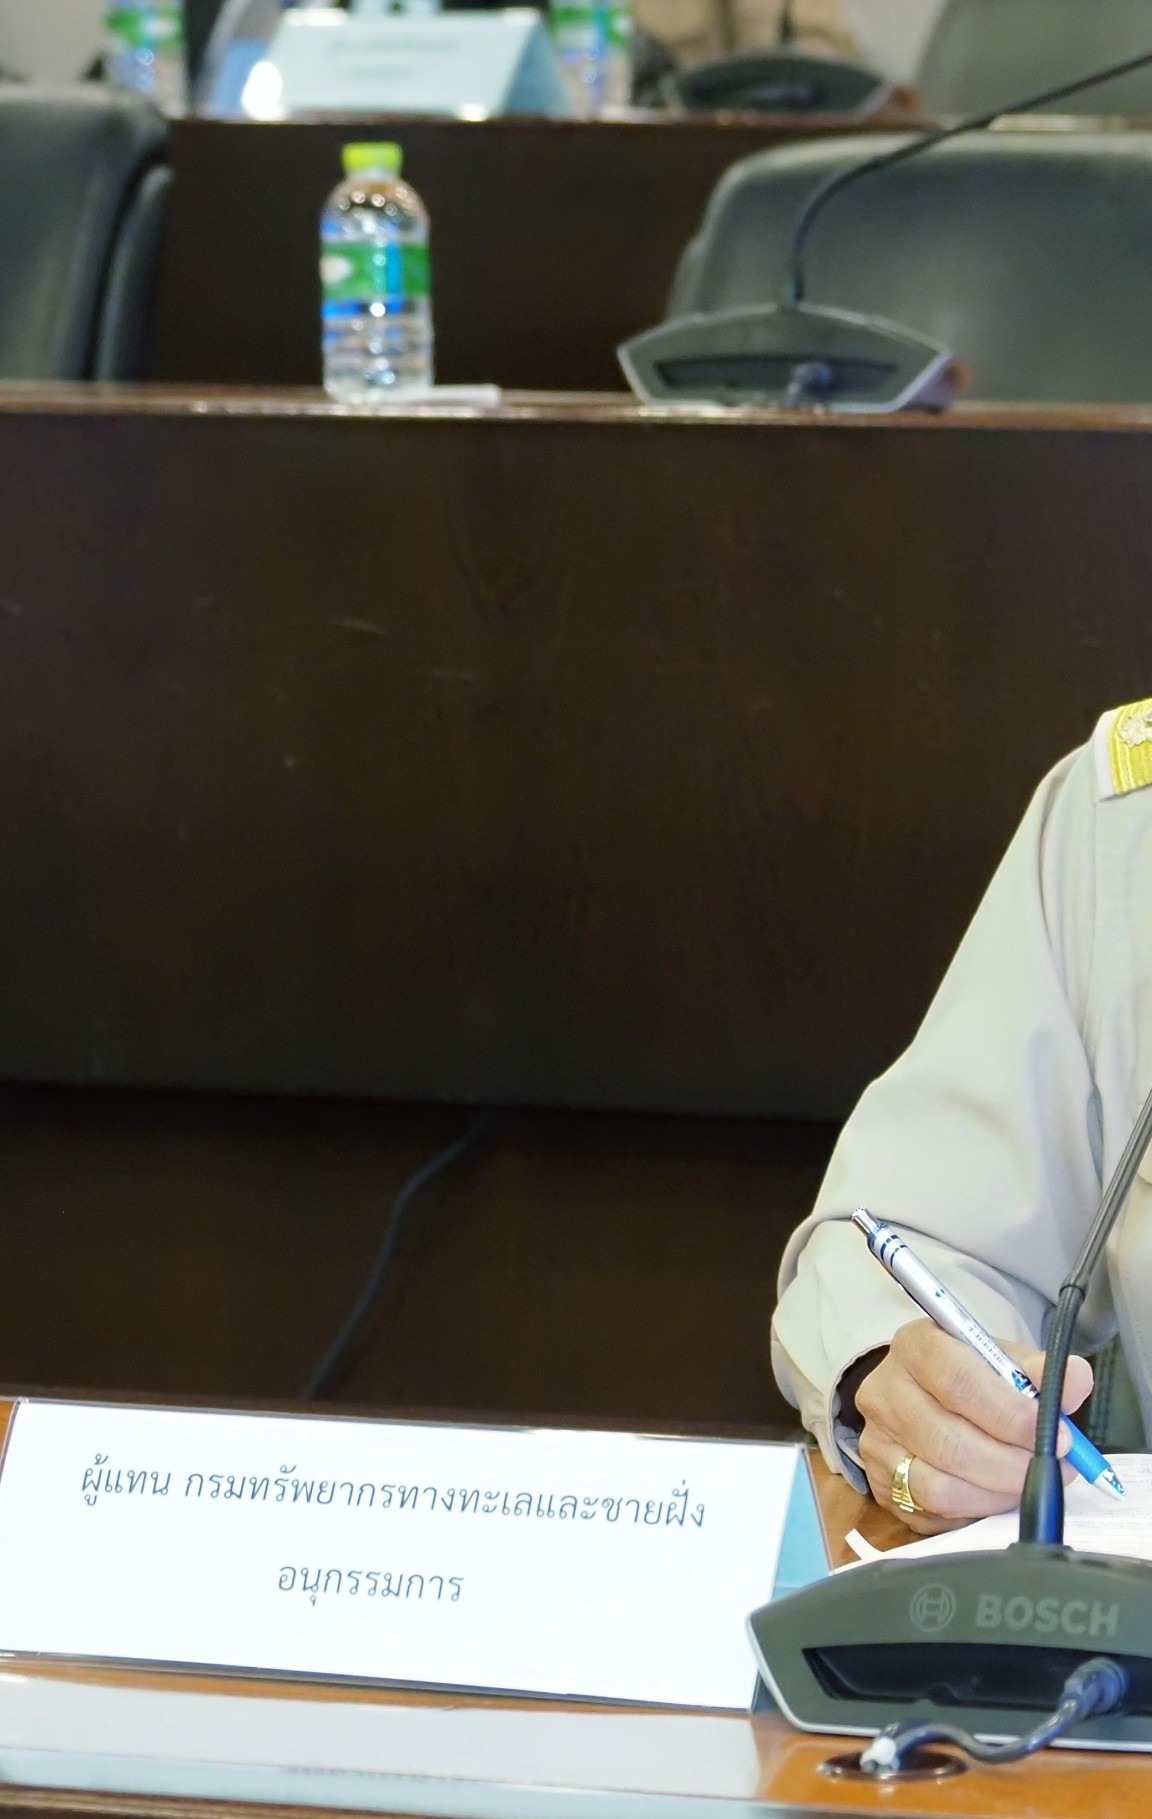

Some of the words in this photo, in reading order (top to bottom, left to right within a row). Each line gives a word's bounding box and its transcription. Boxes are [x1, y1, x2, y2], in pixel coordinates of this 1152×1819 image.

[81, 1453, 170, 1507] ผู้แทน
[185, 1464, 706, 1529] กรมทรัพยากรทางทะเลและชายฝั่ง
[278, 1561, 464, 1606] อนุกรรมการ
[976, 1593, 1120, 1637] BOSCH
